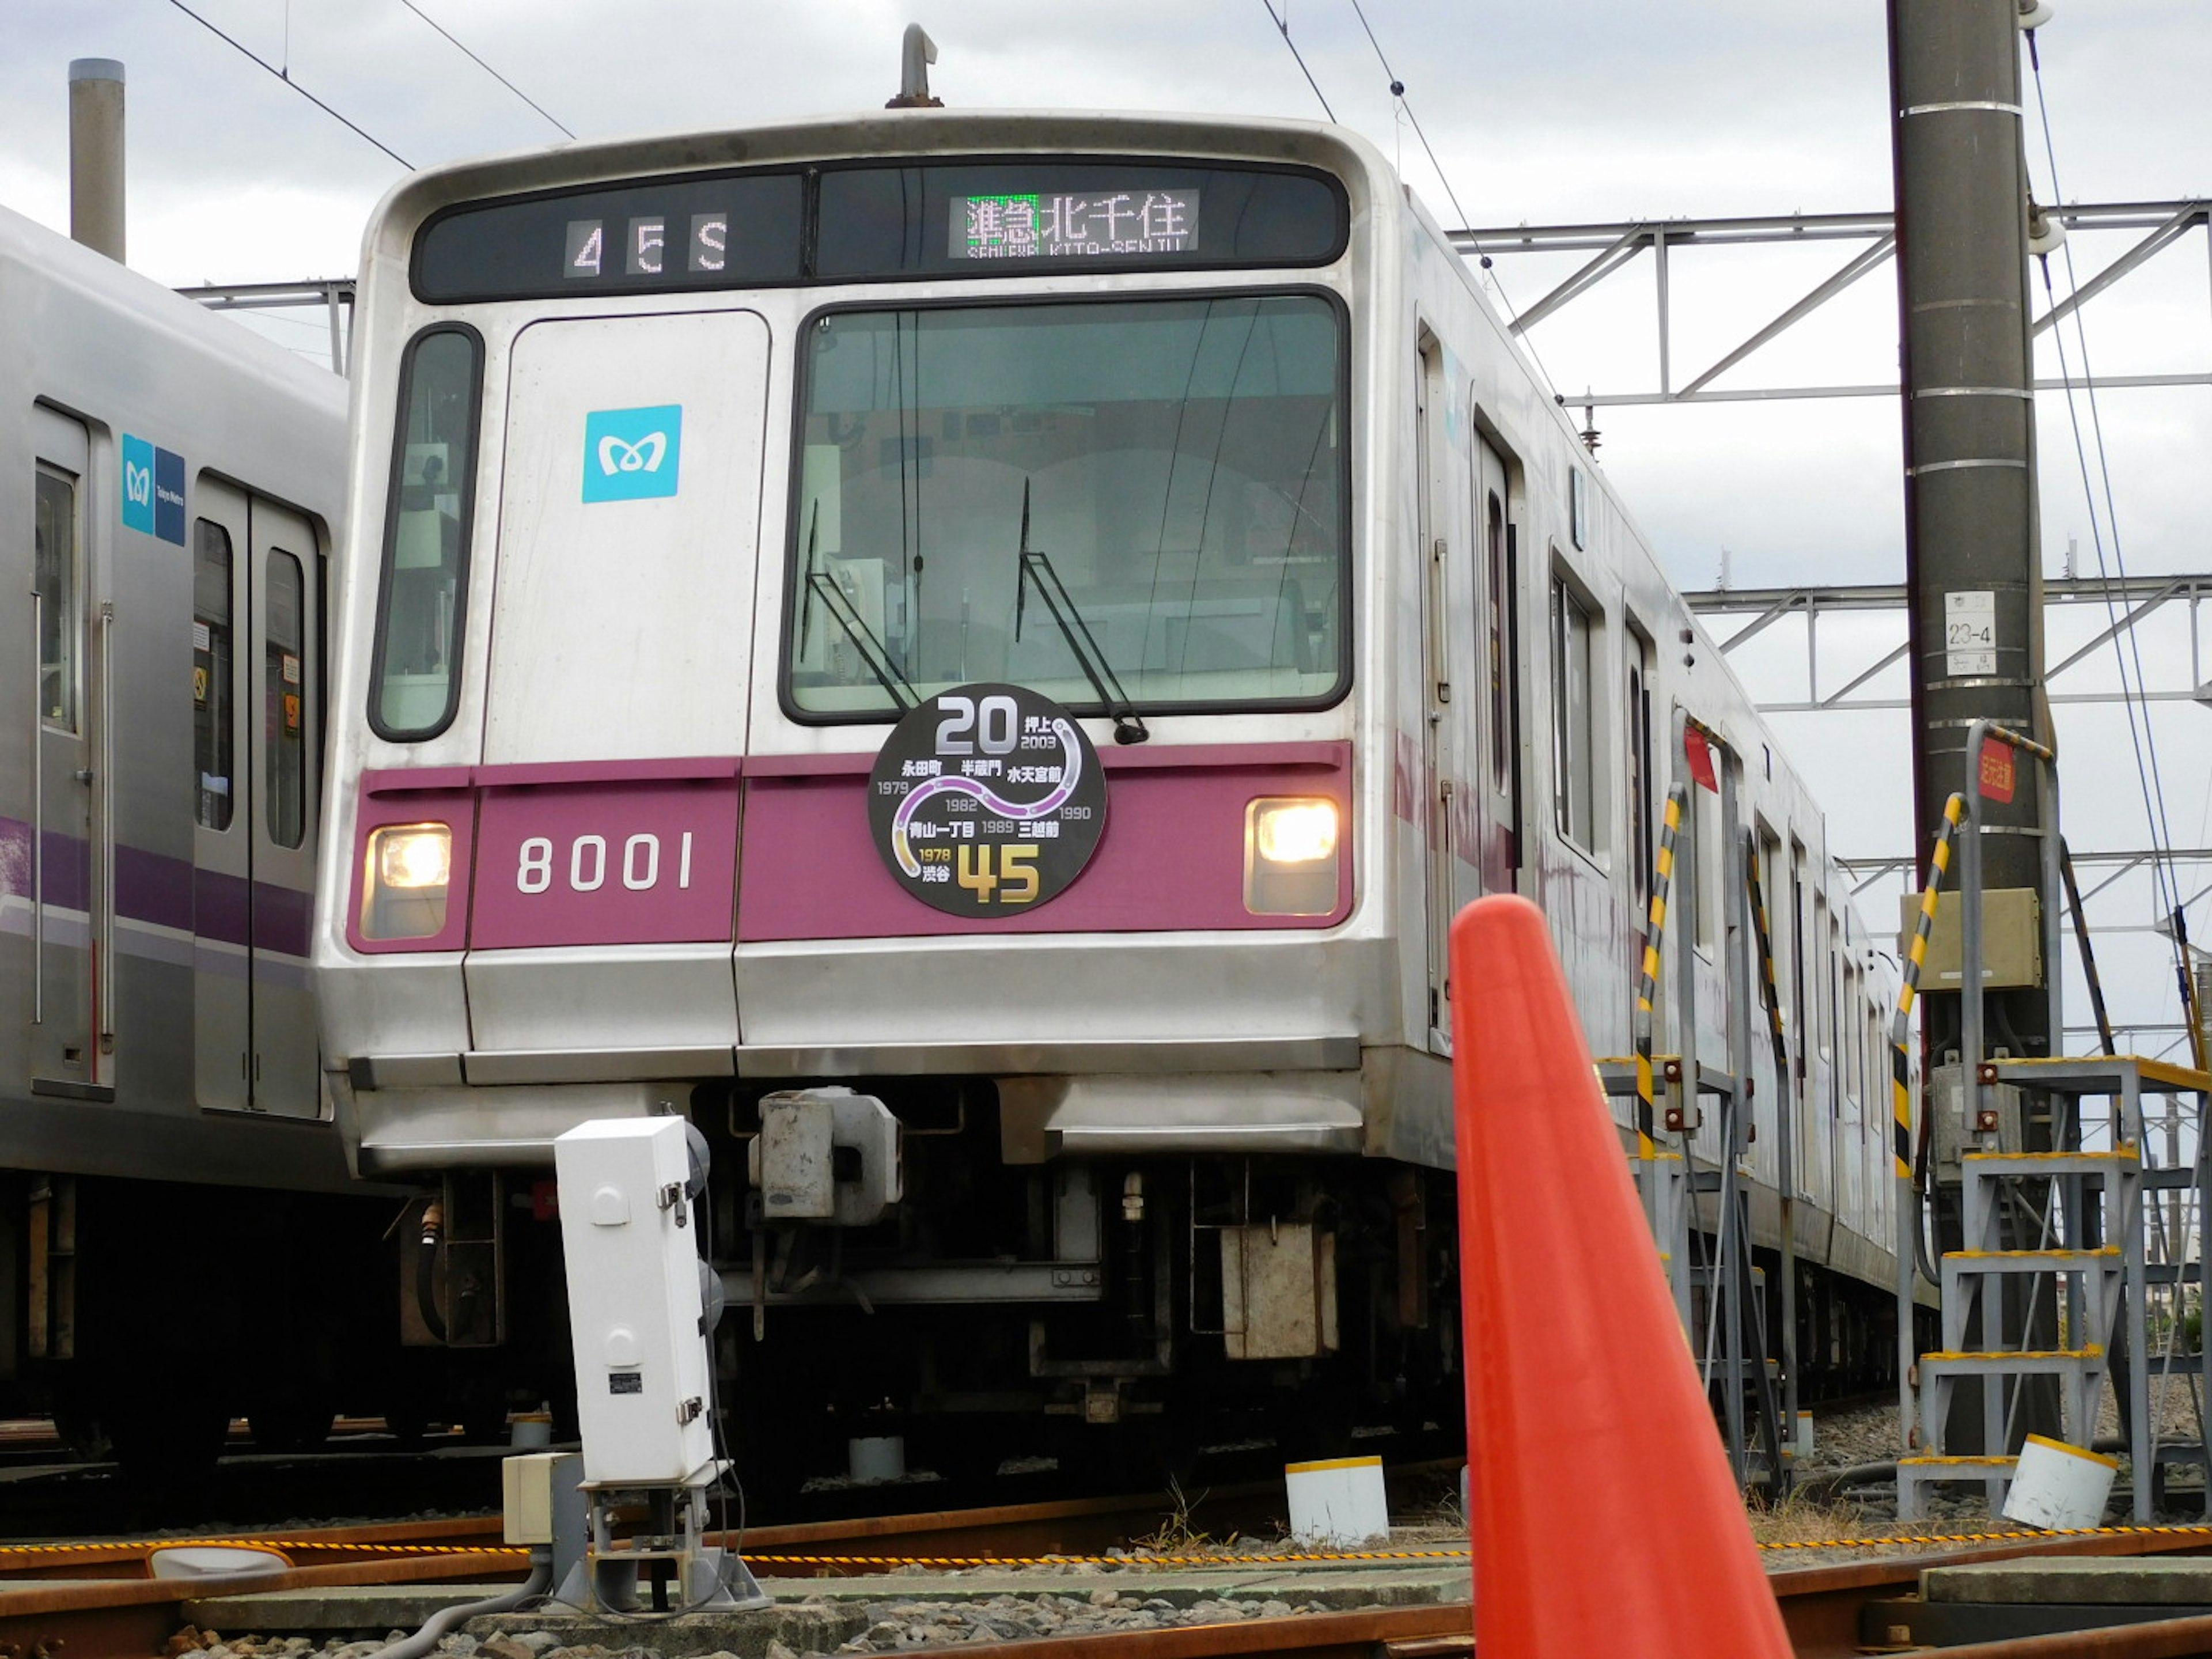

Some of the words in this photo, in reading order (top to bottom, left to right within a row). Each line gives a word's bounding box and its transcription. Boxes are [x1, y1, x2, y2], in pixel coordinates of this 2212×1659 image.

[967, 199, 1039, 245] 準急
[1040, 194, 1188, 242] 北千住
[1949, 623, 1990, 644] 23-4
[935, 695, 1018, 756] 20
[1025, 716, 1051, 733] 押上
[1020, 736, 1056, 749] 2003
[901, 759, 943, 777] 永田町
[961, 759, 1002, 777] 半蔵門
[1006, 766, 1062, 783] 水天宮前
[878, 781, 909, 796] 1979
[945, 798, 978, 812] 1982
[1059, 806, 1092, 820] 1990
[909, 821, 975, 839] 青山一丁目
[982, 820, 1014, 834] 1989
[1017, 821, 1060, 839] 三越前
[517, 831, 692, 894] 8001
[919, 849, 951, 863] 1978
[922, 865, 950, 883] 渋谷
[957, 844, 1040, 903] 45
